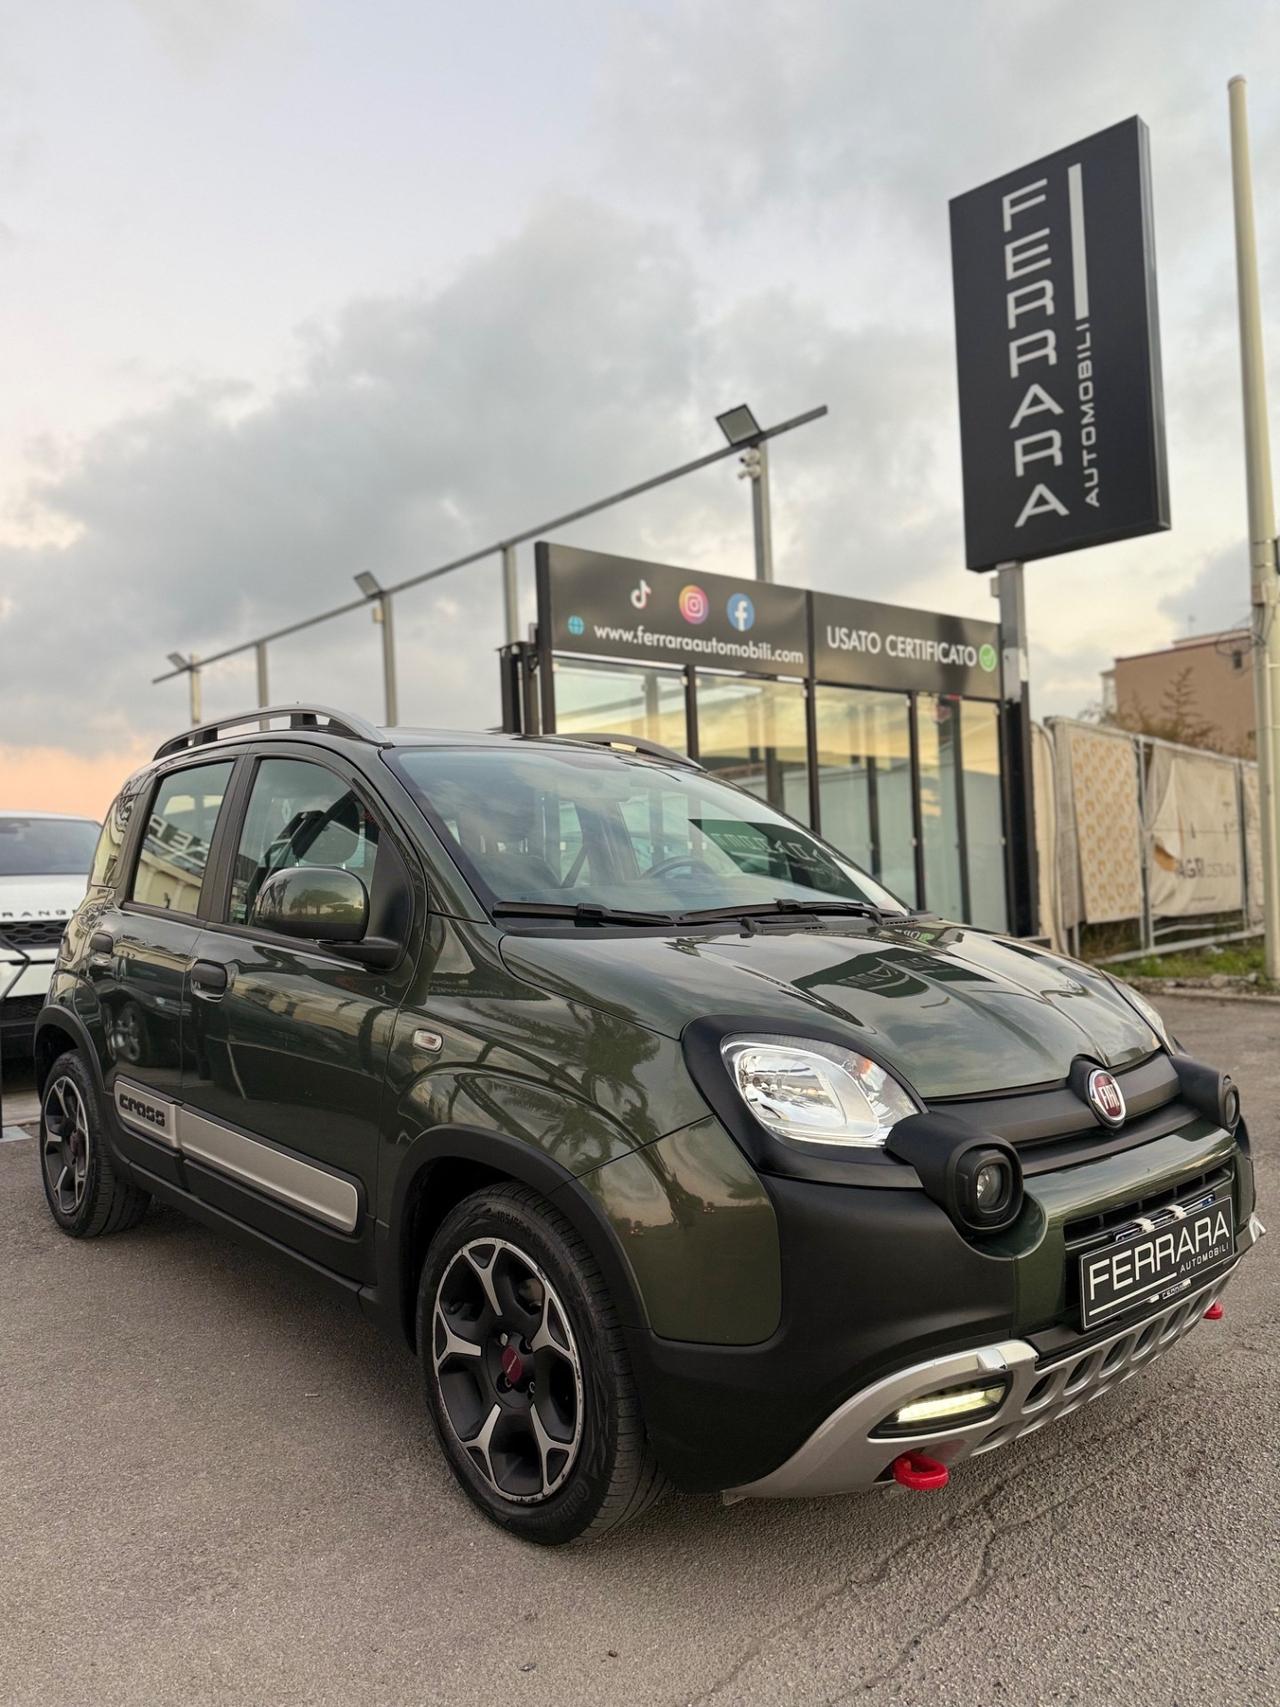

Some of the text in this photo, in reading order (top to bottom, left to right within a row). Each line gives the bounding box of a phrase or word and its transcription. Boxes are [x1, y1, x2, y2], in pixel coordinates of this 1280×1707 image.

[1002, 178, 1070, 528] FERRARA
[1075, 323, 1100, 507] AUTOMOBILI
[593, 625, 804, 664] www.ferraraautomobili.com
[826, 625, 977, 667] USATO CERTIFICATO
[1089, 1211, 1229, 1300] FERRARA
[1180, 1242, 1229, 1273] AUTOMOBILI
